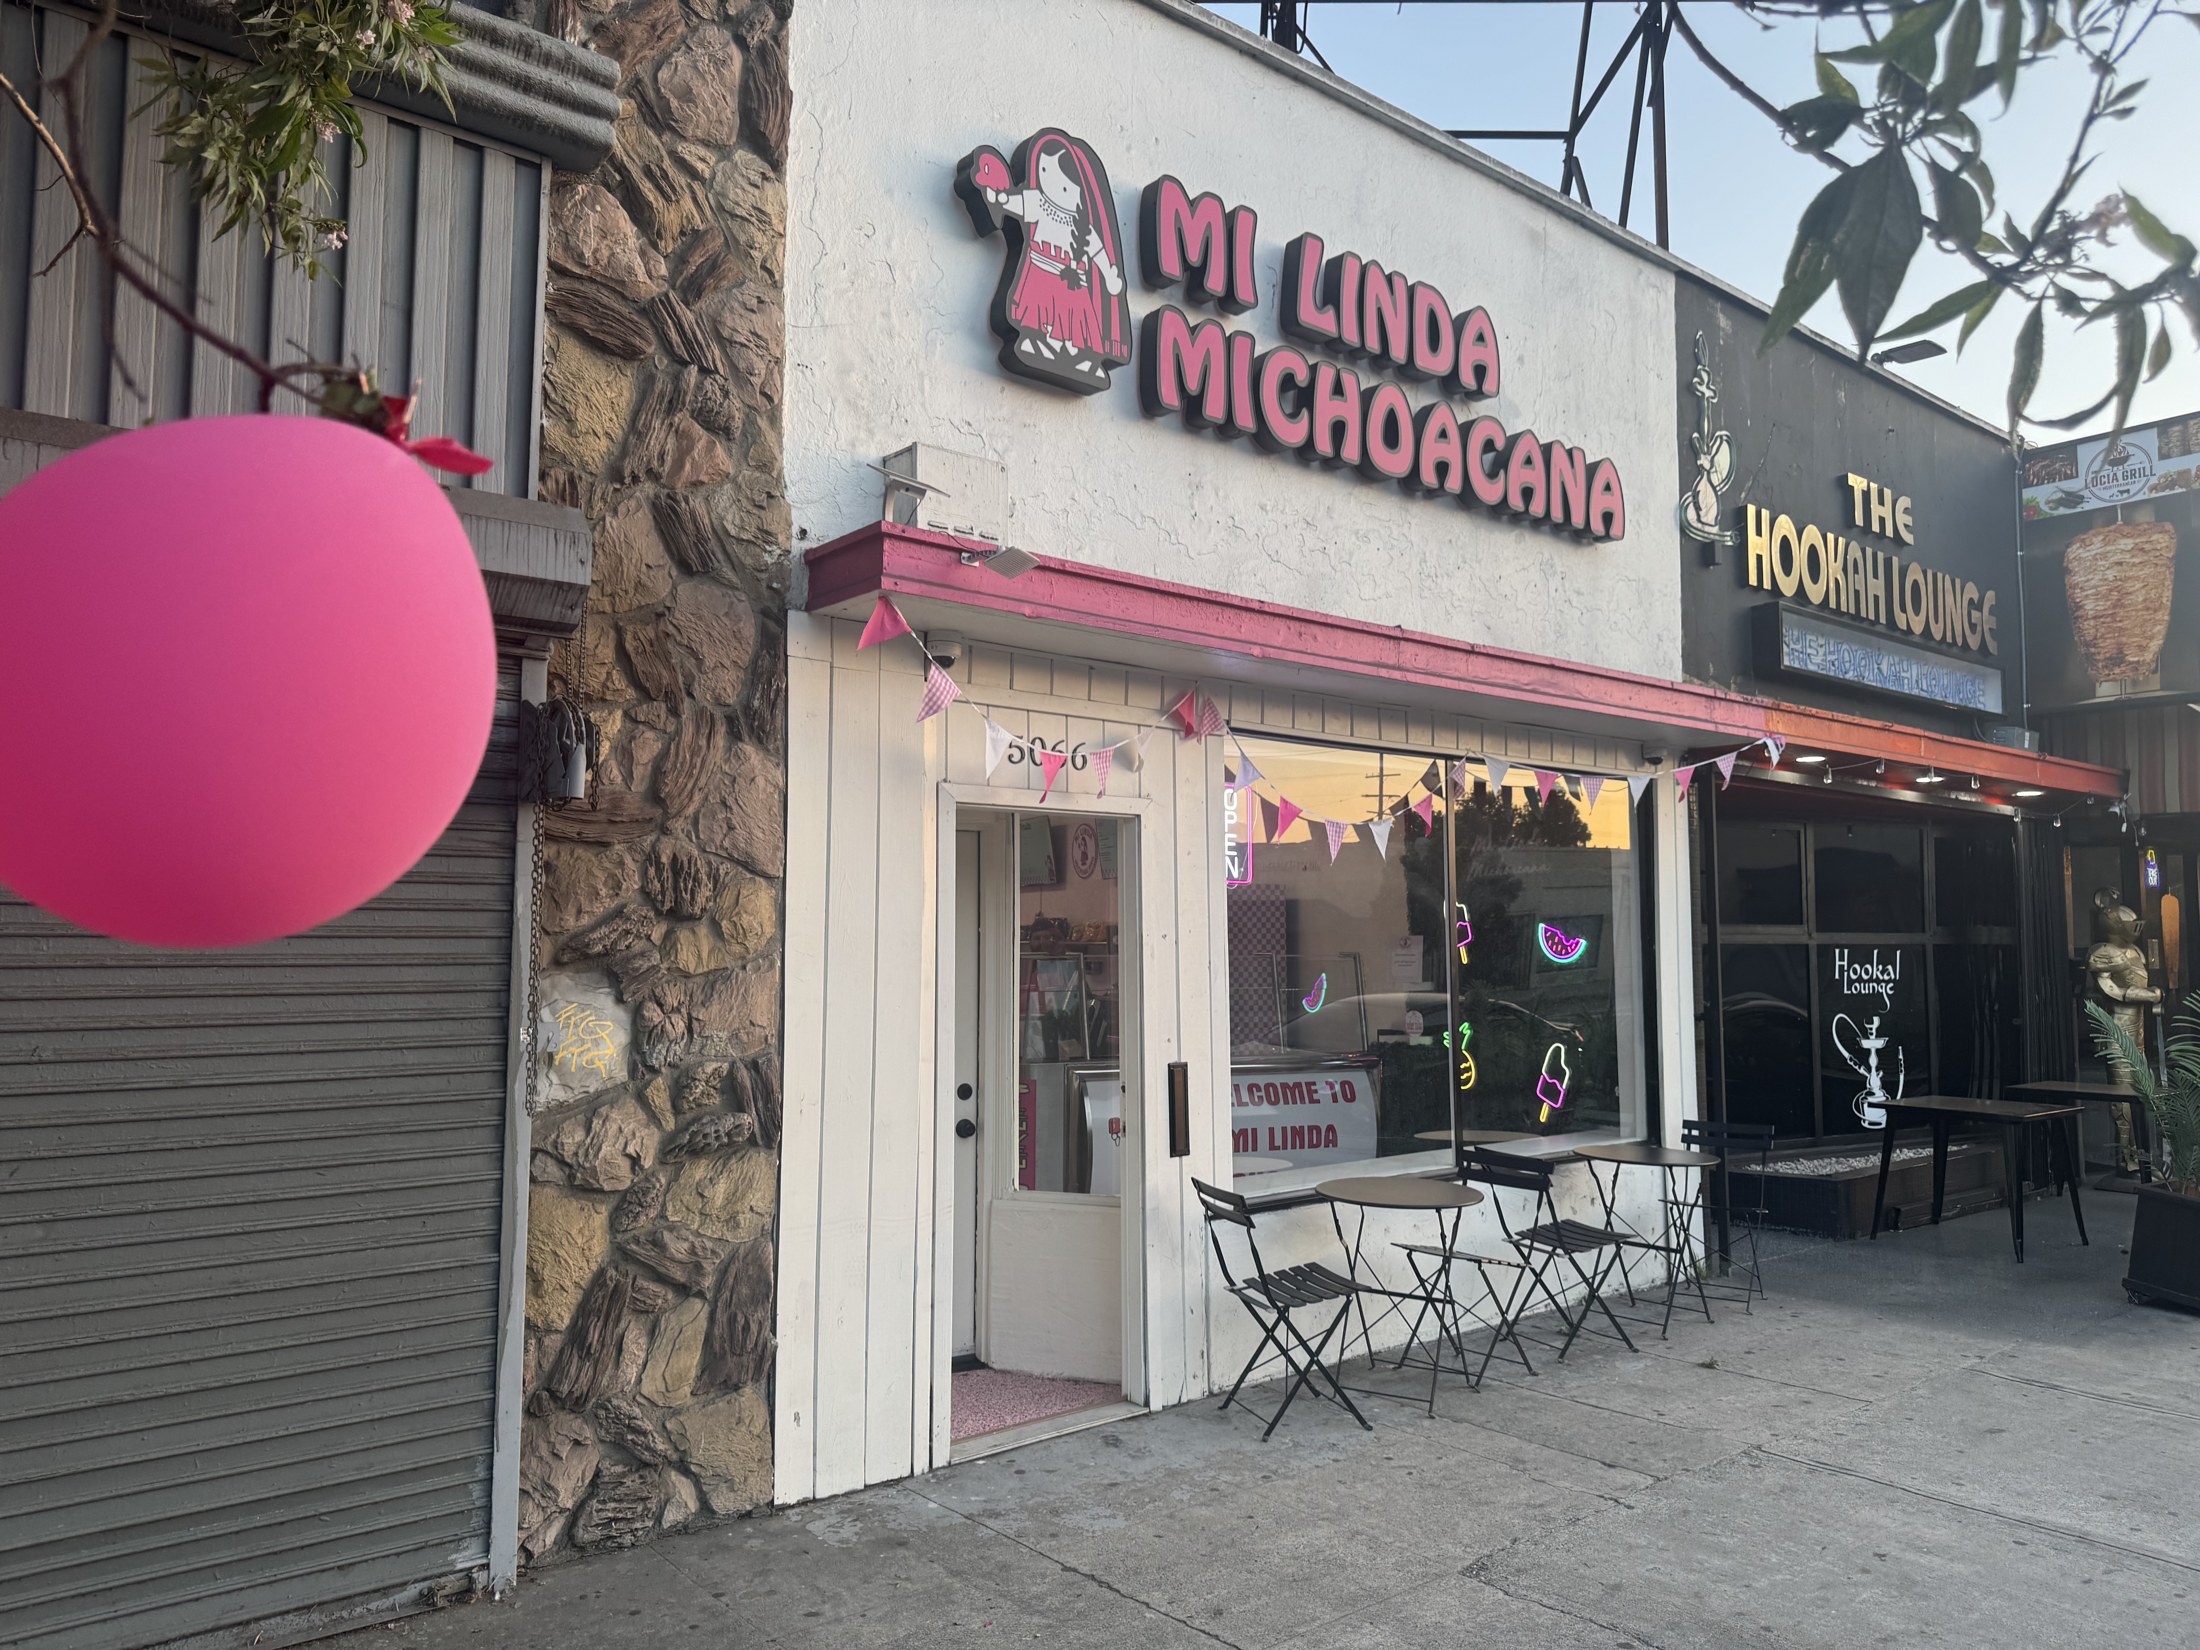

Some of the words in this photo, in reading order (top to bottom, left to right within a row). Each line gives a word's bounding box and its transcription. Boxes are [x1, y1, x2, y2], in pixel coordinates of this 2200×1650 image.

[1139, 174, 1258, 316] MI
[1280, 231, 1500, 401] LINDA
[1140, 303, 1626, 542] MICHOACANA
[1847, 472, 1915, 546] THE
[2122, 465, 2157, 482] GRILL
[1746, 503, 1887, 625] HOOKAH
[1891, 555, 1999, 657] LOUNGE
[1784, 627, 1823, 672] HE
[1825, 638, 1914, 695] HOOKAH
[1916, 661, 1986, 710] LOUNGE
[1007, 734, 1088, 771] 5066
[1224, 788, 1239, 879] OPEN
[1843, 971, 1895, 1013] Lounge
[1325, 1080, 1357, 1103] TO
[1232, 1127, 1258, 1152] MI
[1268, 1124, 1338, 1150] LINDA
